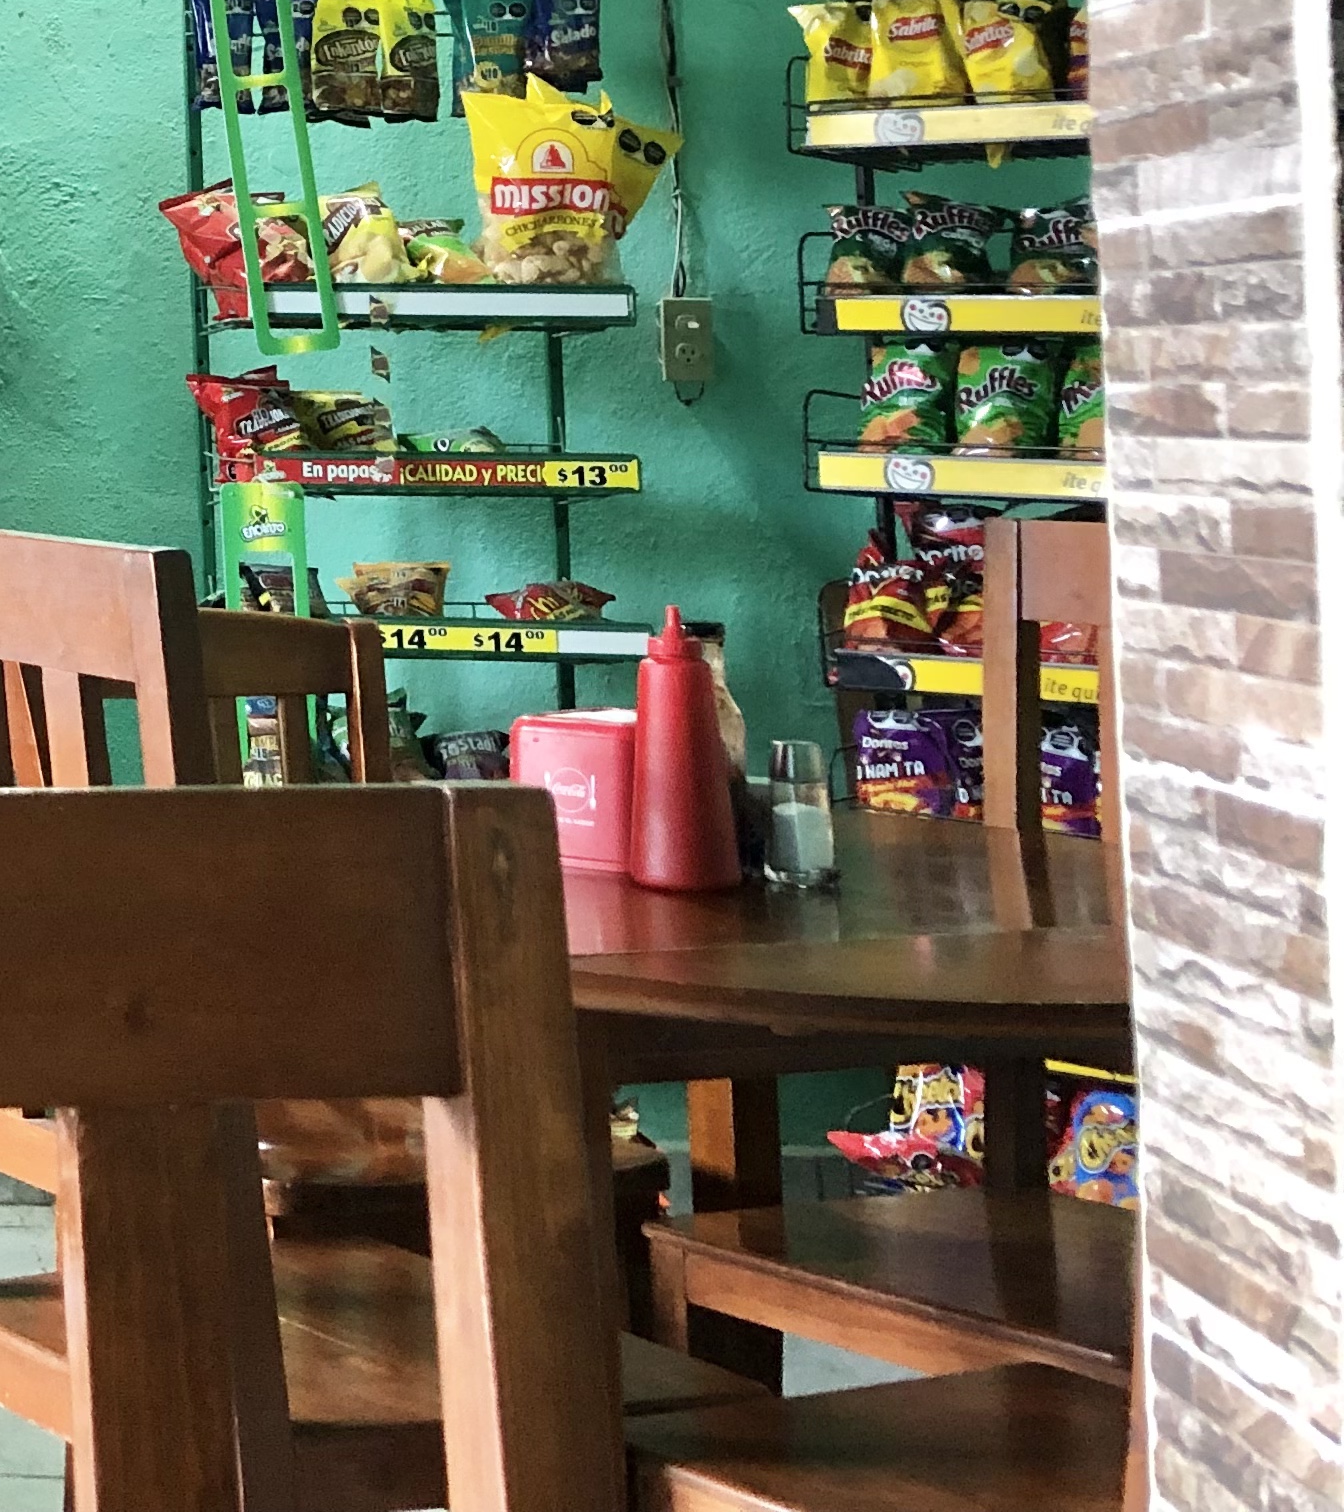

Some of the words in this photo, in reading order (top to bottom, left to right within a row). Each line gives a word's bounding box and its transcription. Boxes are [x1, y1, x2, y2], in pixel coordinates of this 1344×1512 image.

[832, 206, 912, 243] Ruffles
[957, 365, 1041, 415] Ruffles
[302, 461, 322, 478] En
[399, 461, 477, 485] ¡CALIDAD
[480, 467, 494, 486] y
[497, 465, 548, 483] PRECI
[558, 464, 608, 487] $13
[473, 631, 524, 653] $14
